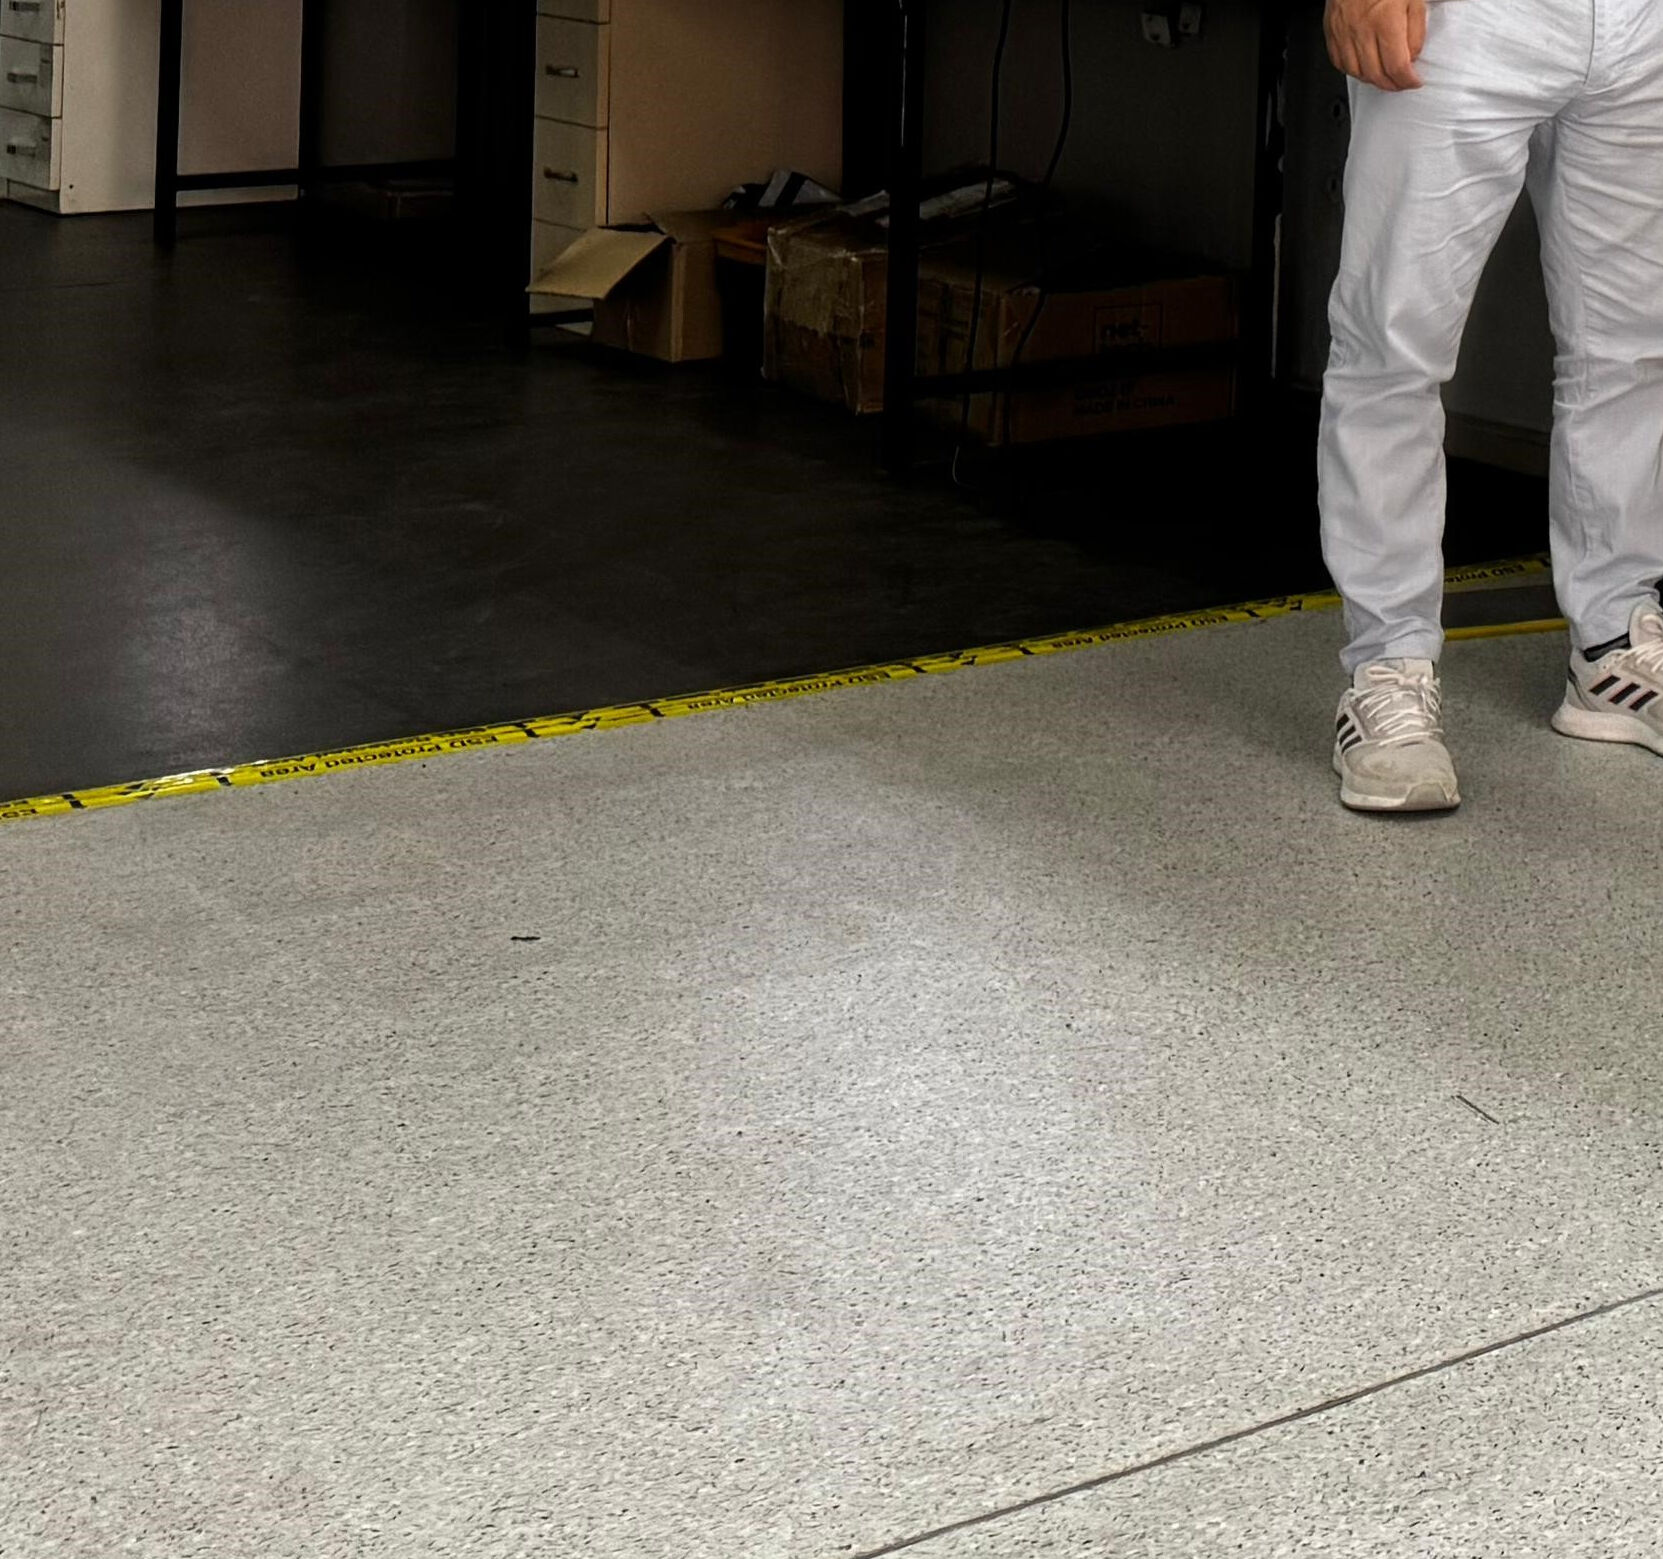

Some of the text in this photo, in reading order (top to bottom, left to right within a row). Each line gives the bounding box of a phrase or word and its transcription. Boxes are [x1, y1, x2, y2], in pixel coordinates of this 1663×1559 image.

[449, 734, 498, 749] ESD
[325, 743, 442, 769] Protected
[260, 762, 317, 780] Area
